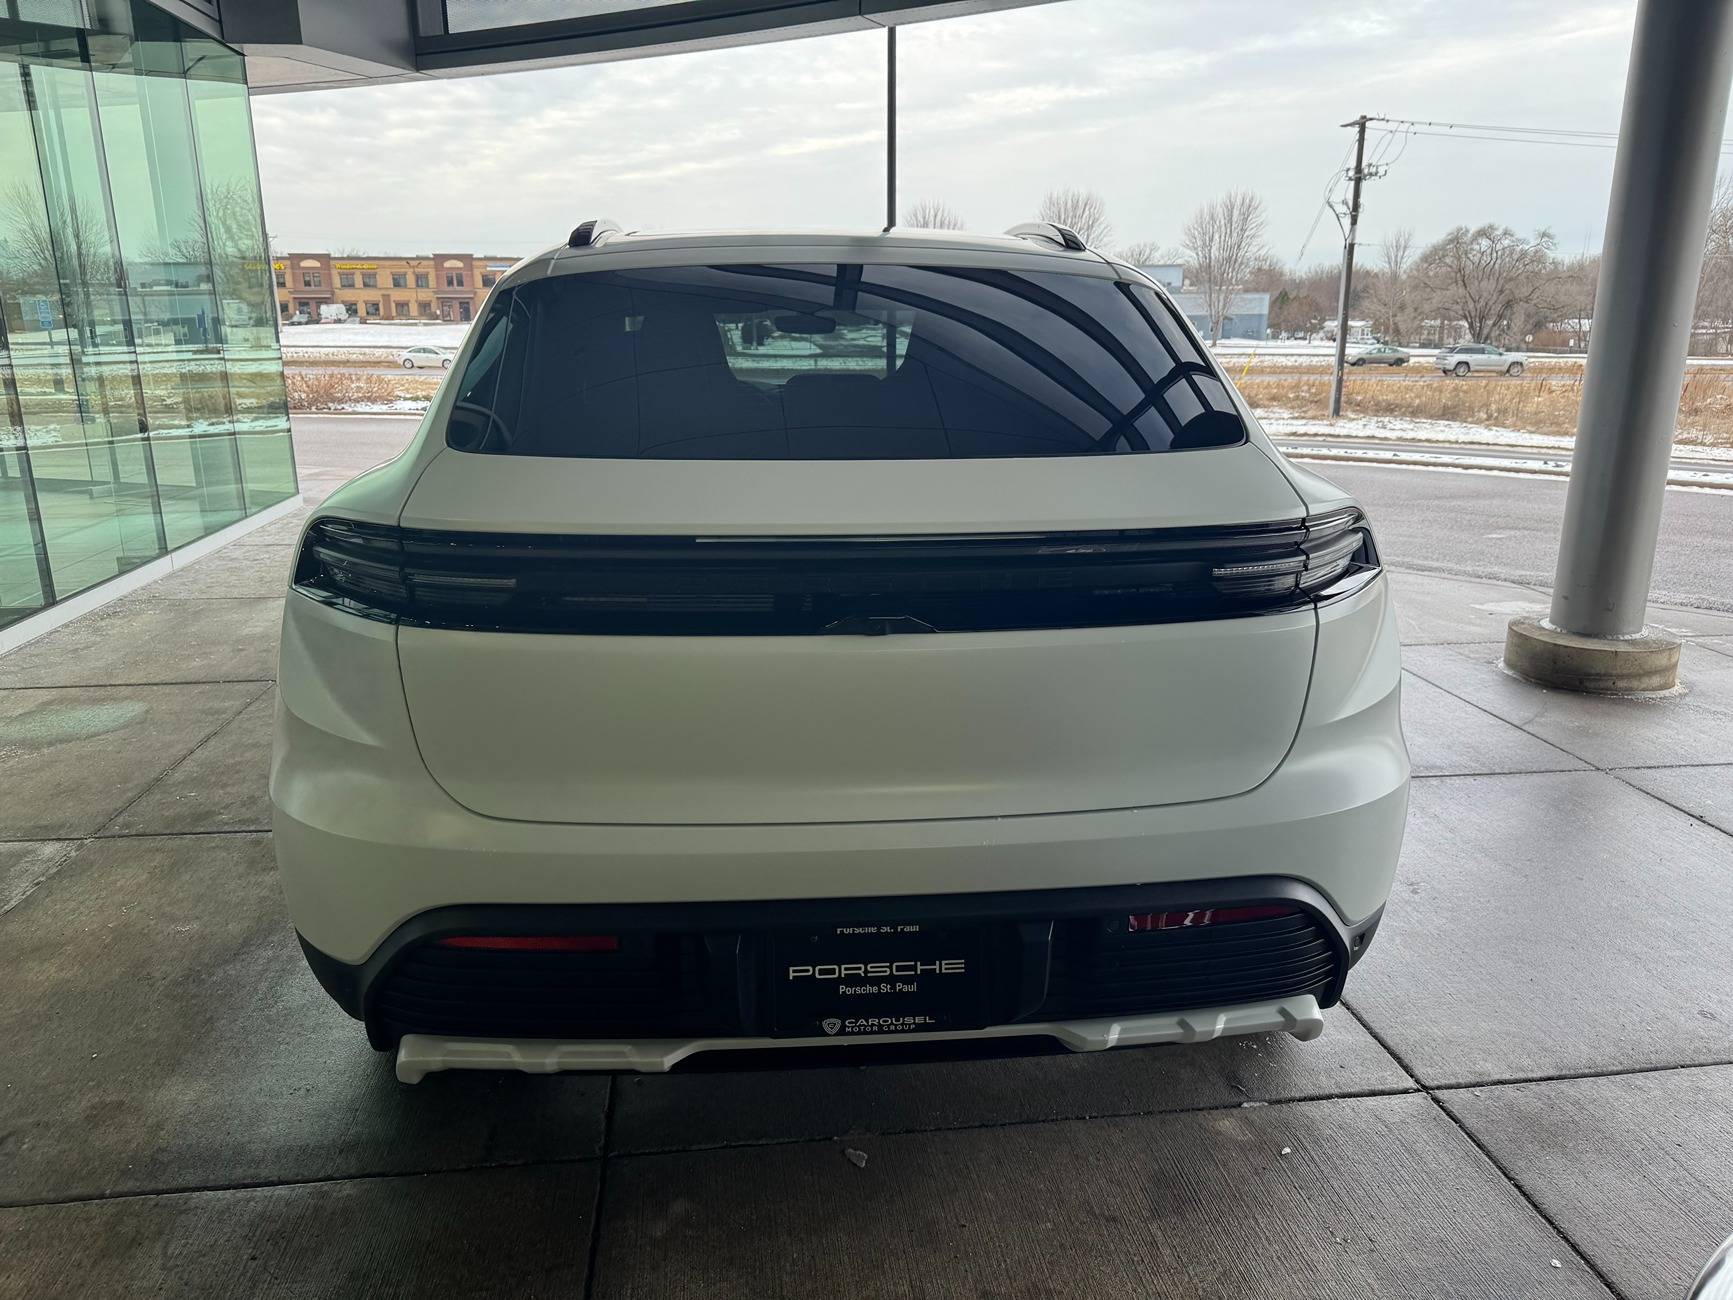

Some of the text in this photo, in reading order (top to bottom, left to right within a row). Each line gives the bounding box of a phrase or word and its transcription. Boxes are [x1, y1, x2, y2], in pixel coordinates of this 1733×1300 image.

[789, 959, 965, 980] PORSCHE
[839, 982, 917, 995] Porsche St. Paul
[845, 1016, 936, 1026] CAROUSEL
